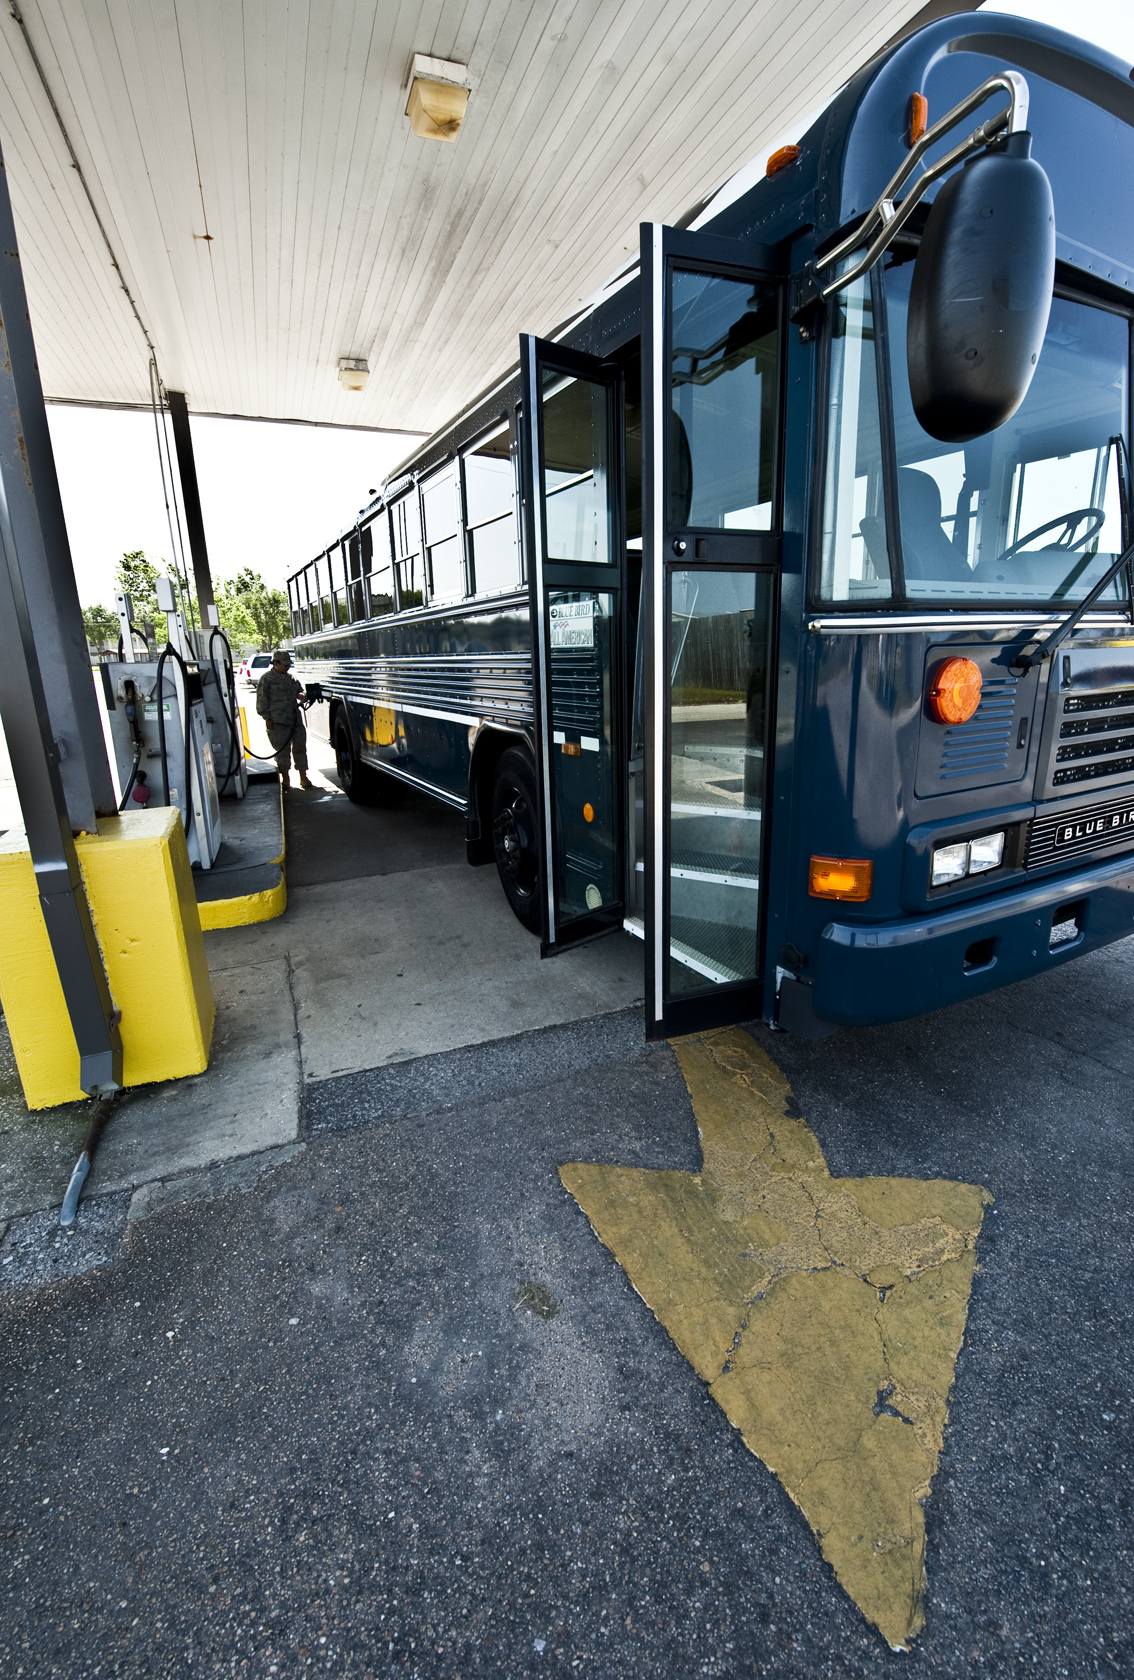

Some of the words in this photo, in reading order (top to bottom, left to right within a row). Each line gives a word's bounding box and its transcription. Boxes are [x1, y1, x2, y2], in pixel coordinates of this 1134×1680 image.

[558, 605, 573, 618] BLUE
[574, 603, 591, 616] BIRD
[562, 627, 593, 646] AMERICAN
[1064, 819, 1105, 840] BLUE
[1112, 811, 1134, 827] BIR
